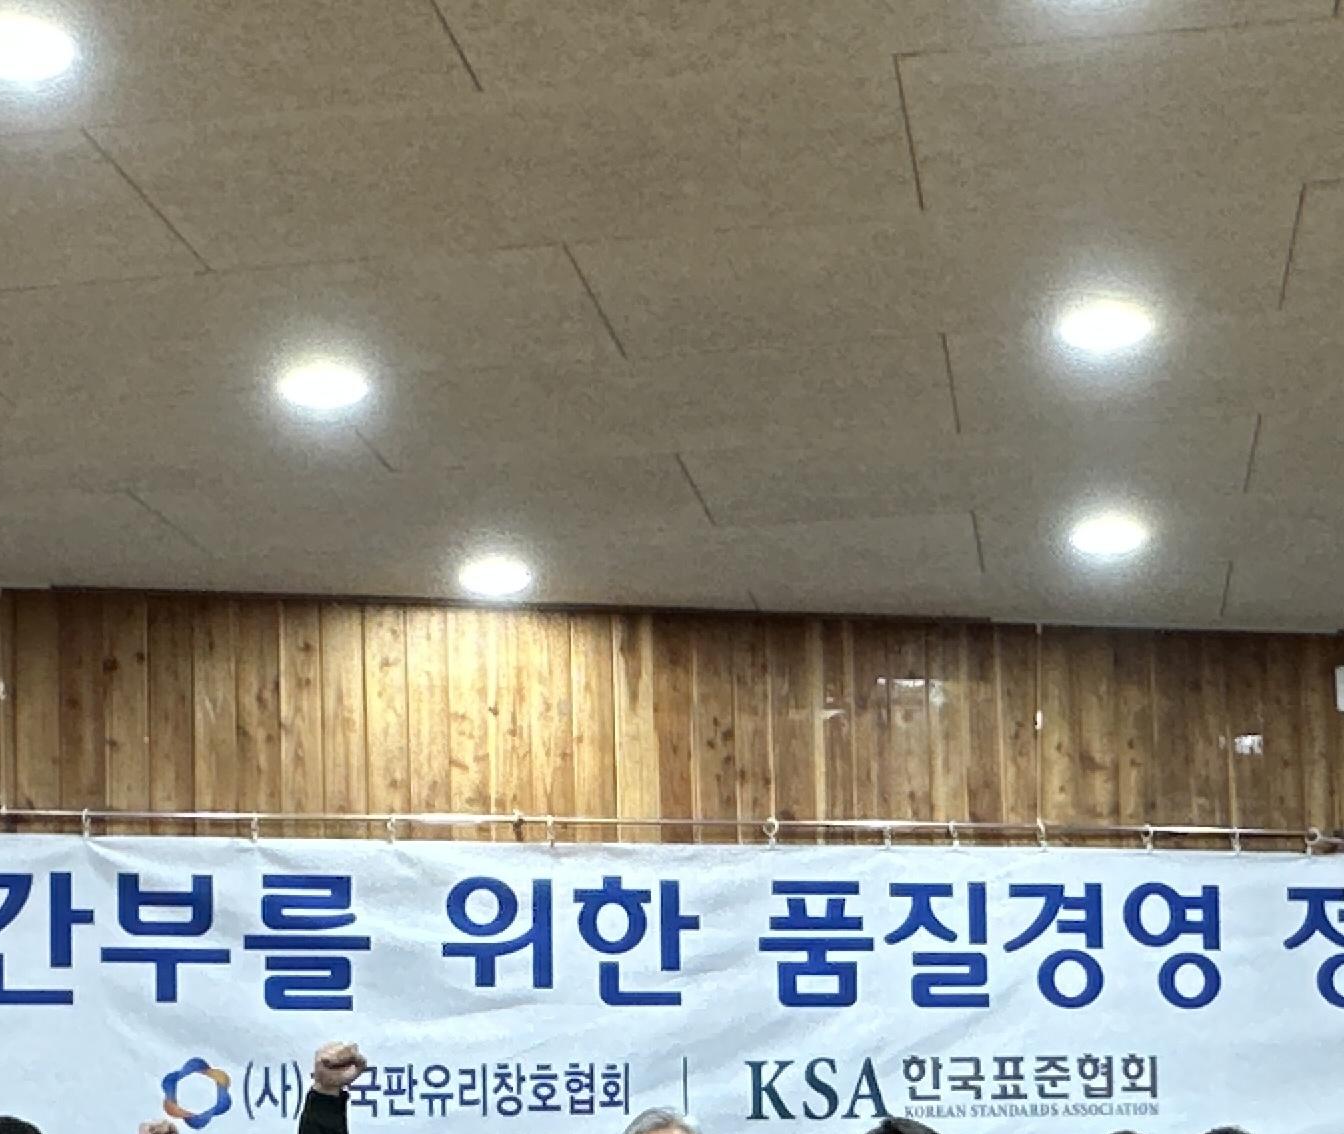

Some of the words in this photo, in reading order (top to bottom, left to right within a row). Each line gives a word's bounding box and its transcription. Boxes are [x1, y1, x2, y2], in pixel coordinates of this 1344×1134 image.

[442, 876, 700, 1006] 위한
[758, 880, 1222, 1010] 품질경영
[243, 1060, 631, 1119] (사)국판유리창호협회
[744, 1057, 891, 1121] KSA
[902, 1053, 1158, 1101] 한국표준협회
[904, 1105, 966, 1119] KOREAN
[969, 1104, 1058, 1118] STANDARDS
[1061, 1102, 1160, 1117] ASSOCIATION
